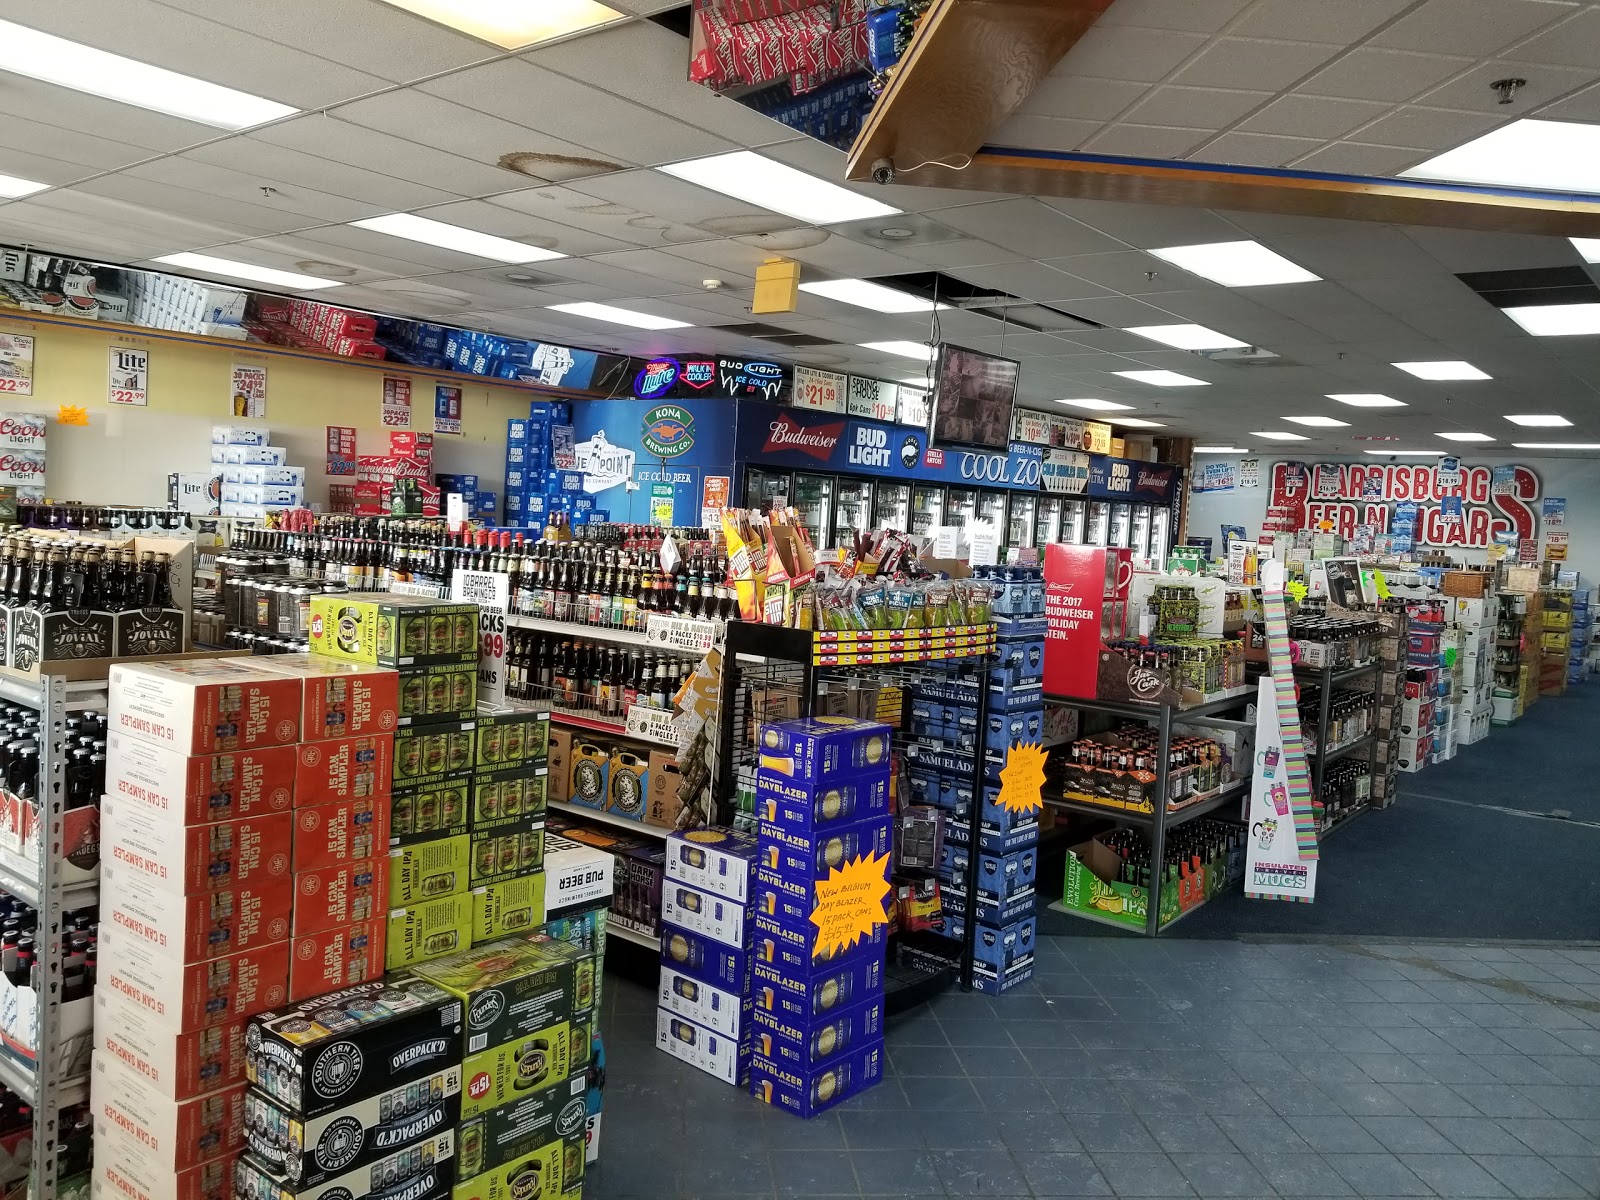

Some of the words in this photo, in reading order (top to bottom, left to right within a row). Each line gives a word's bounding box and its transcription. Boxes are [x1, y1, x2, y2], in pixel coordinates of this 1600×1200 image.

[117, 352, 146, 370] Lite
[646, 363, 670, 372] Miller
[686, 364, 702, 373] WALK
[703, 364, 712, 373] IN
[720, 360, 743, 370] BUD
[748, 364, 782, 375] LIGHT
[642, 366, 675, 394] Lite
[687, 372, 712, 381] COOLER
[736, 376, 747, 384] ICE
[748, 377, 767, 386] COLD
[834, 374, 845, 382] LIGHT
[852, 378, 878, 390] SPRING
[111, 390, 145, 403] $22.99
[806, 384, 835, 406] $21.99
[855, 389, 880, 400] HOUSE
[656, 408, 680, 420] KONA
[859, 405, 872, 414] Cans
[872, 402, 894, 420] $10.99
[0, 418, 46, 438] Coors
[770, 421, 837, 448] Budweiser
[1024, 428, 1040, 440] $10.99
[857, 427, 886, 446] BUD
[646, 440, 678, 454] BREWING
[927, 450, 942, 458] STELLA
[1014, 444, 1041, 456] BEER-N-CIG
[0, 454, 46, 474] Coors
[600, 455, 631, 472] POINT
[850, 446, 891, 468] LIGHT
[638, 472, 650, 480] ICE
[651, 472, 672, 482] COLD
[672, 473, 692, 483] BEER
[961, 454, 1010, 484] COOL
[1012, 456, 1040, 490] ZO
[1112, 462, 1130, 478] BUD
[1137, 470, 1168, 487] Budweiser
[1313, 463, 1490, 504] ARISBURG
[768, 574, 786, 582] ORIGINAL
[794, 574, 813, 585] ORIGINAL
[1046, 594, 1061, 605] THE
[1062, 596, 1082, 606] 2017
[480, 605, 490, 613] PUB
[490, 606, 502, 614] BEER
[1046, 606, 1094, 620] BUDWEISER
[481, 614, 504, 633] CKS
[670, 620, 682, 630] MIX
[690, 622, 713, 634] MATCH
[54, 632, 104, 646] JOVIAL
[128, 630, 176, 642] JOVIAL
[670, 636, 694, 646] SINGLES
[675, 630, 692, 639] PACKS
[1252, 634, 1262, 642] 24
[480, 668, 496, 684] ANS
[263, 696, 270, 707] 15
[352, 680, 362, 731] SAMPLER
[246, 688, 260, 744] SAMPLER
[260, 710, 269, 733] CAN
[338, 744, 349, 796] SAMPLER
[920, 754, 956, 768] SAMUEL
[956, 760, 974, 773] ADA
[758, 781, 808, 800] DAYBLAZER
[784, 810, 793, 820] 15
[761, 827, 810, 848] DAYBLAZER
[631, 862, 654, 878] DARK
[1254, 862, 1308, 870] INSULATED
[560, 874, 584, 890] BEER
[586, 870, 604, 884] PUB
[631, 874, 654, 887] HORSE
[758, 873, 806, 896] DAYBLAZER
[1067, 853, 1077, 904] EVOLUTION
[1254, 874, 1306, 888] MUGS
[820, 886, 838, 900] NEW
[840, 882, 871, 894] BELGIUM
[820, 900, 834, 912] DAY
[835, 896, 867, 908] BLAZER
[855, 908, 872, 916] CANS
[606, 913, 633, 930] ARIETY
[634, 920, 654, 936] PACK
[298, 981, 384, 1013] OVERPACK'D
[472, 998, 498, 1018] Founders
[264, 1041, 296, 1068] OVERPACK'D
[392, 1040, 446, 1068] OVERPACK'D
[314, 1042, 346, 1083] SOUTHERN
[346, 1043, 360, 1073] TIER
[519, 1055, 545, 1076] Founders
